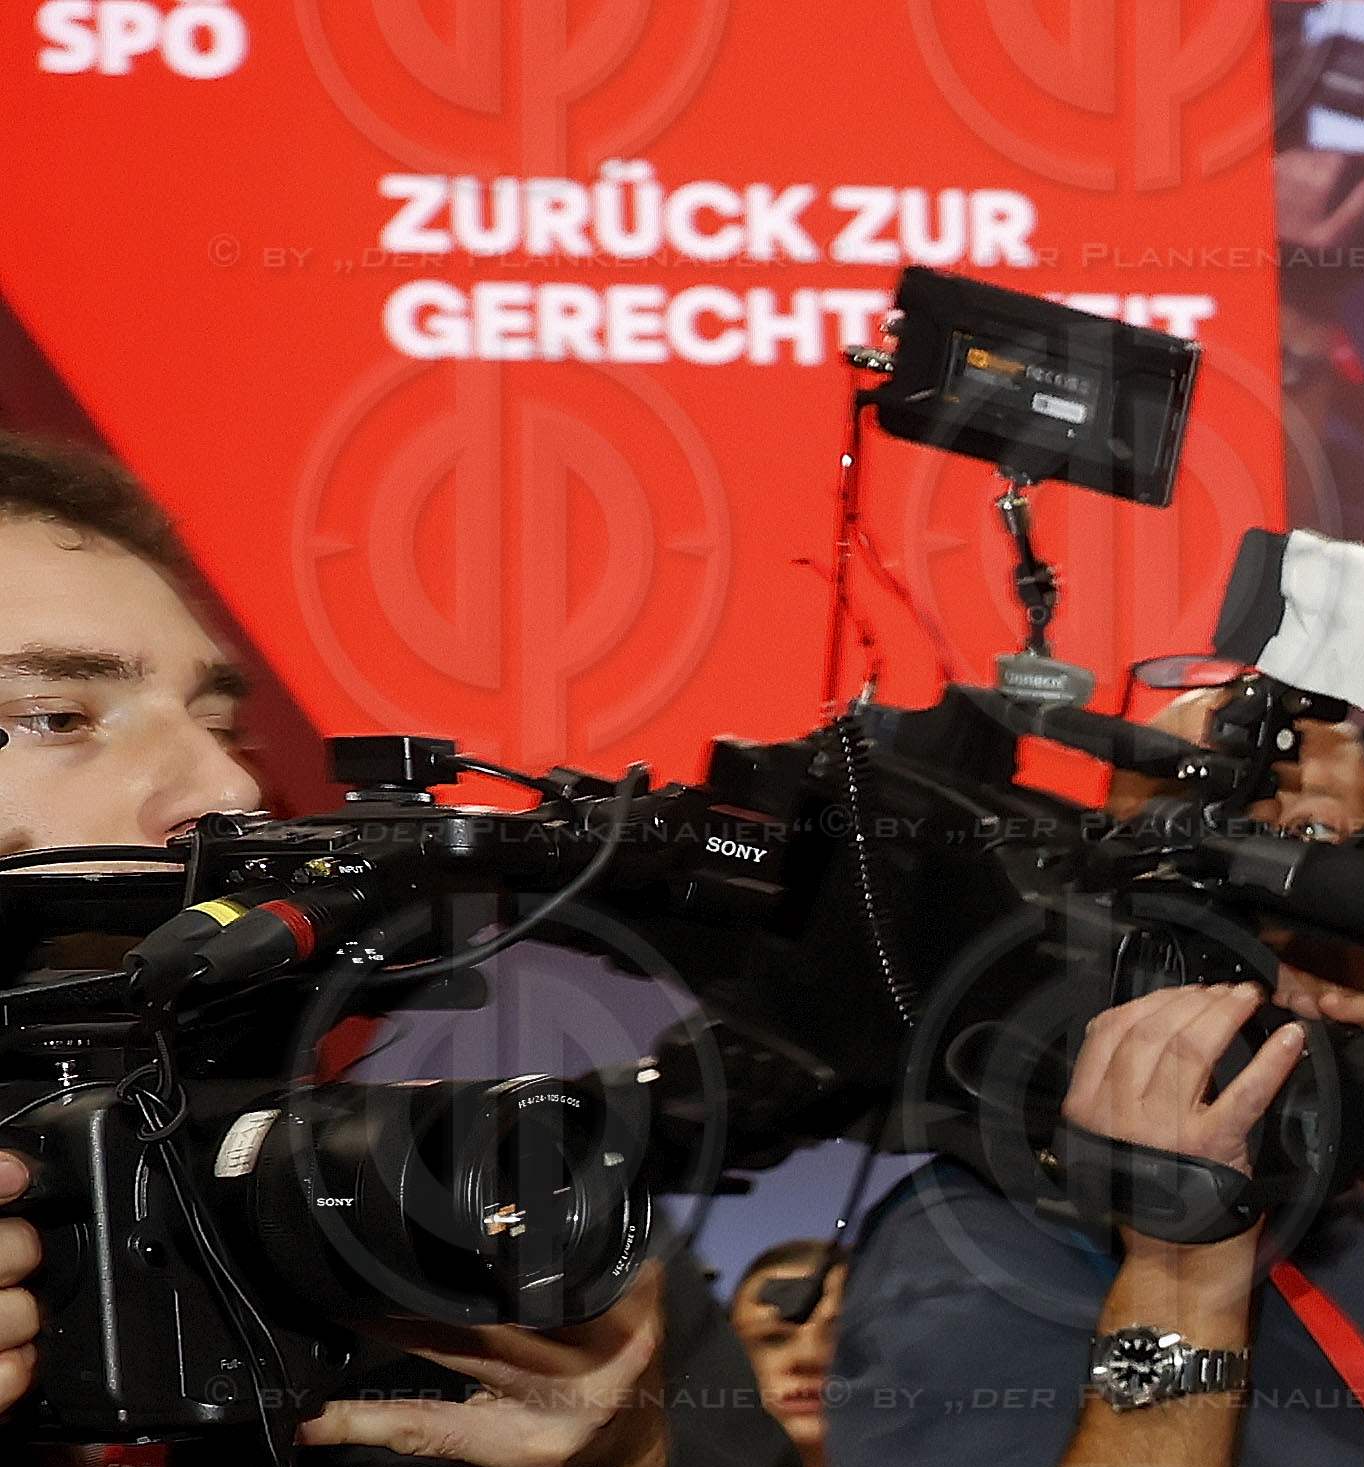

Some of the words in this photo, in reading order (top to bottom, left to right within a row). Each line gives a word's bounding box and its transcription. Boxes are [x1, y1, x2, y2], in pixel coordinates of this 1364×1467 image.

[35, 0, 247, 78] SPÖ
[379, 159, 822, 263] ZURÜCK
[830, 185, 1039, 268] ZUR
[383, 279, 1216, 367] GERECHTT
[339, 865, 364, 874] INPUT
[706, 837, 768, 863] SONY
[316, 1198, 354, 1207] SONY
